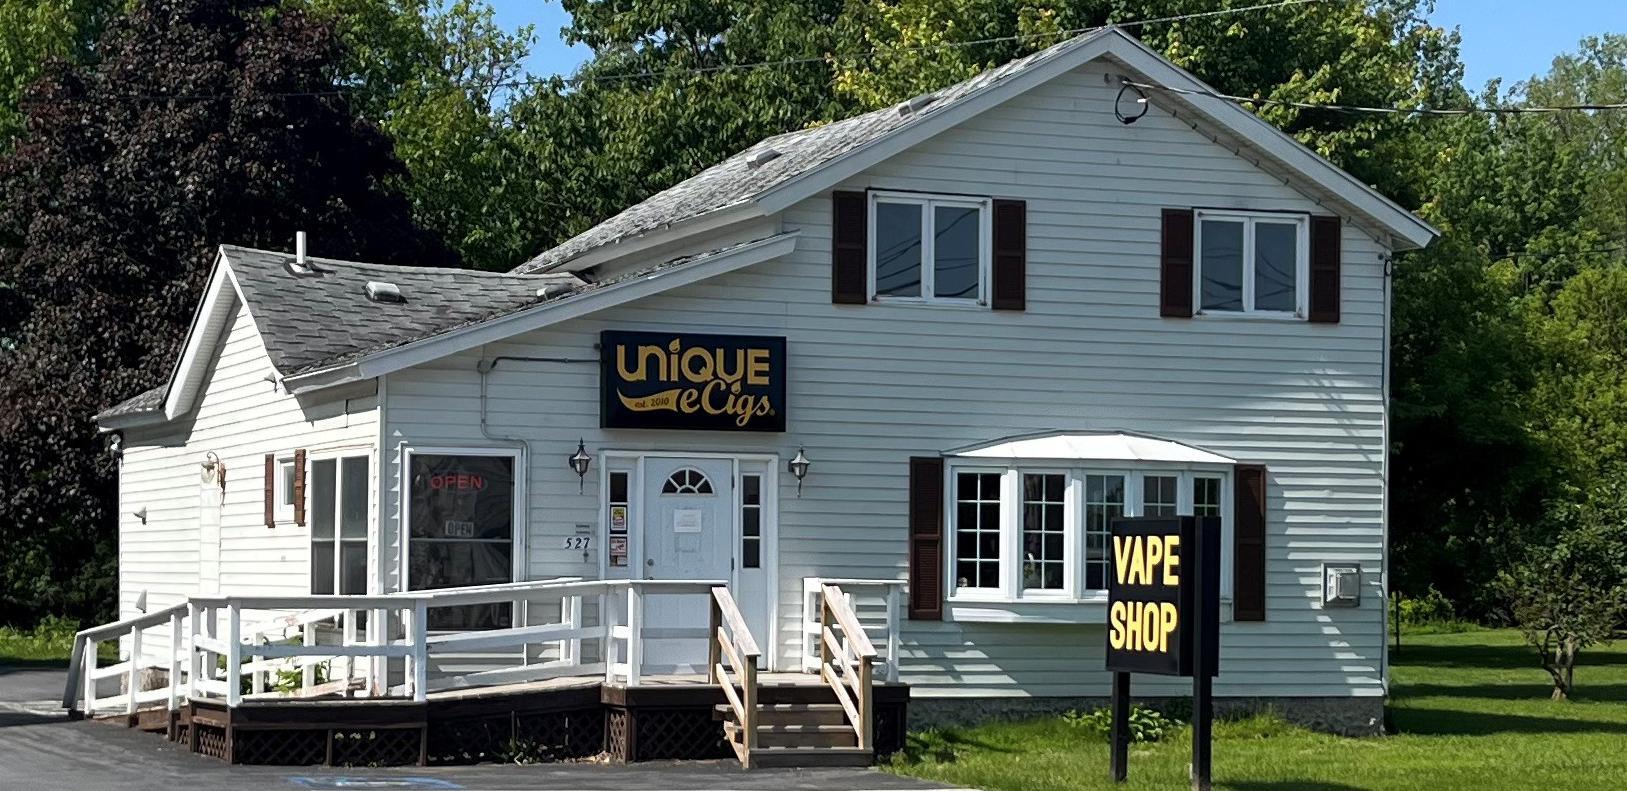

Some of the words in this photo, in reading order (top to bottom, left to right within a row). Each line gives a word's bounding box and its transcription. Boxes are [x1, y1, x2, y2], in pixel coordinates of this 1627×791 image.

[651, 397, 670, 408] 2010
[431, 475, 482, 489] OPEN
[447, 520, 473, 537] OPEN
[564, 537, 590, 550] 527
[1113, 535, 1180, 585] VAPE
[1109, 600, 1178, 652] SHOP
